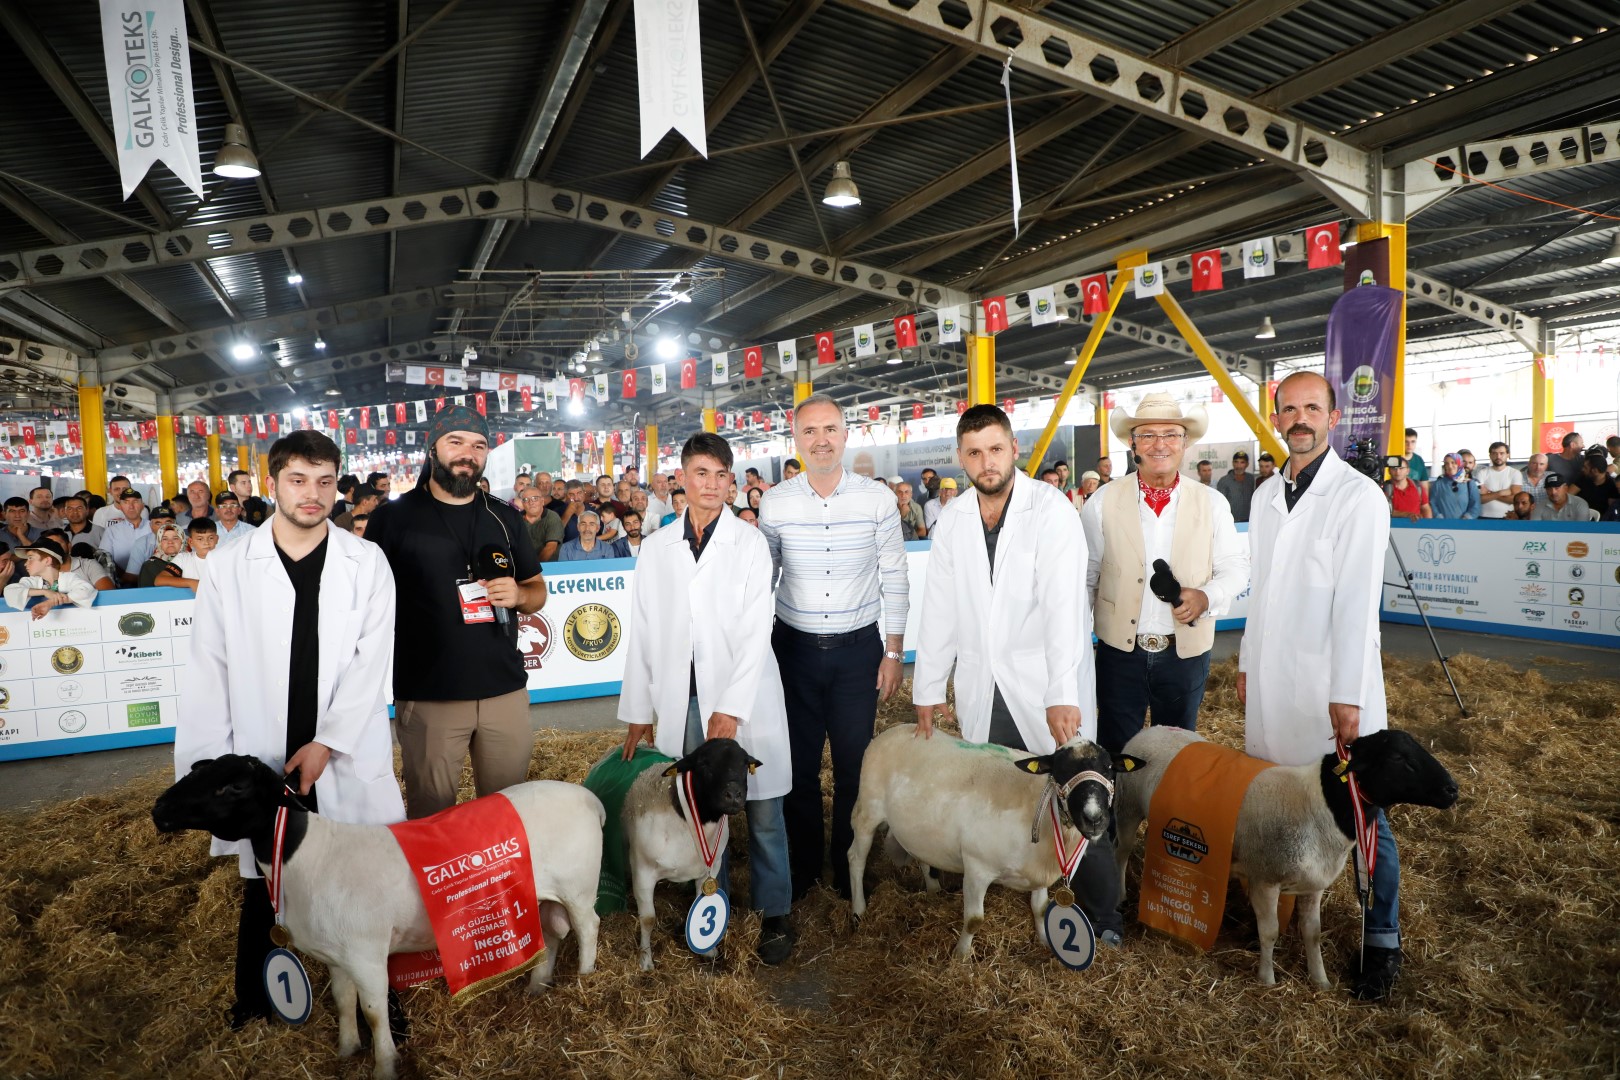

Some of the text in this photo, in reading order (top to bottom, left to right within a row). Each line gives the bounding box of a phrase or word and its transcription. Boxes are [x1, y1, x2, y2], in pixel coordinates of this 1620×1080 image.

[122, 11, 154, 149] GALKOTEKS
[174, 73, 188, 135] Professional
[1345, 405, 1378, 415] İNEGÖL
[1523, 542, 1547, 551] APEX
[1434, 573, 1478, 583] HAYVANCILIK
[1435, 584, 1469, 595] FESTİVALİ
[577, 607, 588, 616] DE
[590, 606, 617, 623] FRANCE
[33, 628, 66, 638] BİSTE
[1164, 831, 1180, 842] EŞREF
[428, 838, 519, 885] GALKOTEKS
[446, 879, 489, 903] Professional
[1155, 880, 1192, 898] YARIŞMASI
[1162, 874, 1197, 892] GÜZELLİK
[1161, 893, 1195, 914] İNEGÖL
[452, 907, 511, 936] IRK GÜZELLİK
[460, 919, 508, 941] YARIŞMASI
[700, 906, 716, 936] 3
[1173, 912, 1192, 926] EYLÜL
[1194, 919, 1208, 934] 2022
[474, 930, 516, 950] İNEGÖL
[1059, 918, 1080, 952] 2
[460, 951, 494, 972] 16-17-18
[496, 942, 518, 959] EYLÜL
[278, 971, 292, 1004] 1
